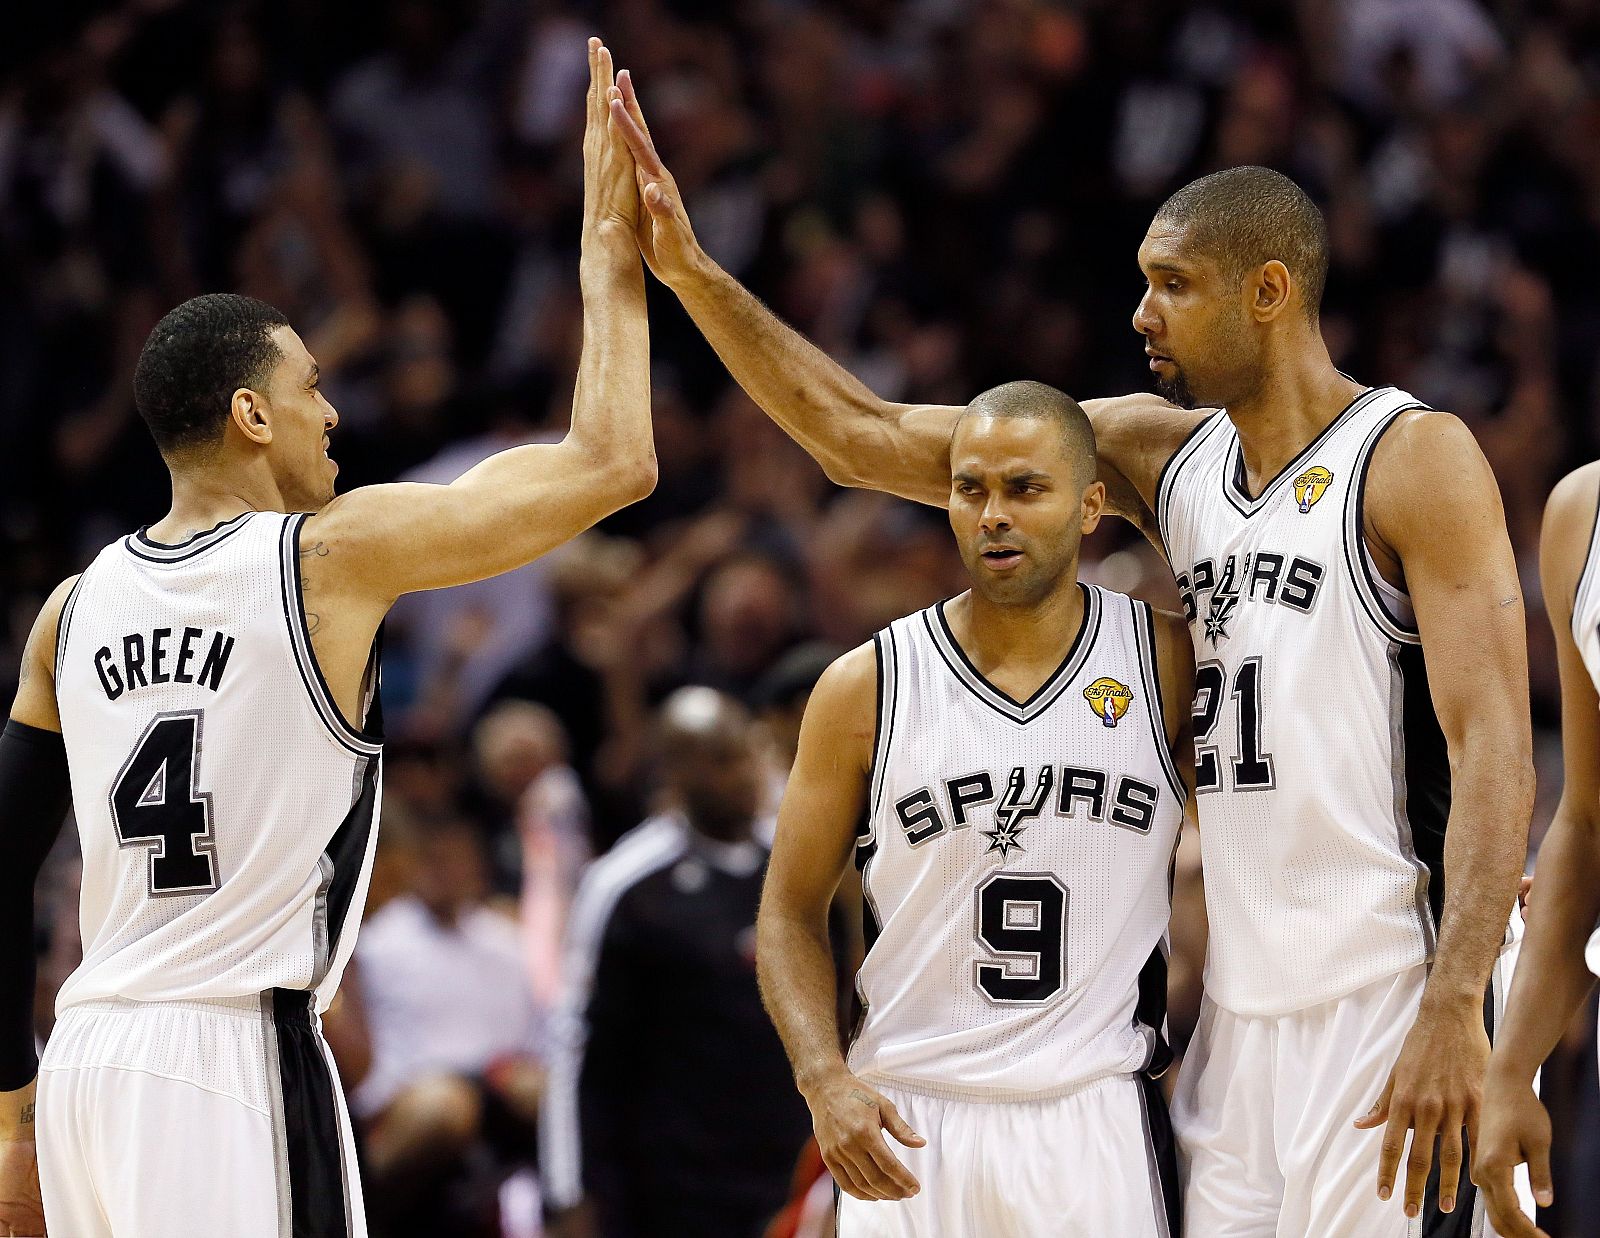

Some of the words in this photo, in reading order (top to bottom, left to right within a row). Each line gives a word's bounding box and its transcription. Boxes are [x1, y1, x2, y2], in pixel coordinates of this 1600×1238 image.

[1177, 551, 1327, 651] SPURS
[94, 632, 235, 700] GREEN
[1098, 684, 1131, 698] Finals
[1192, 655, 1276, 793] 21
[108, 708, 221, 899] 4
[894, 765, 1160, 863] SPURS
[973, 871, 1070, 1007] 9
